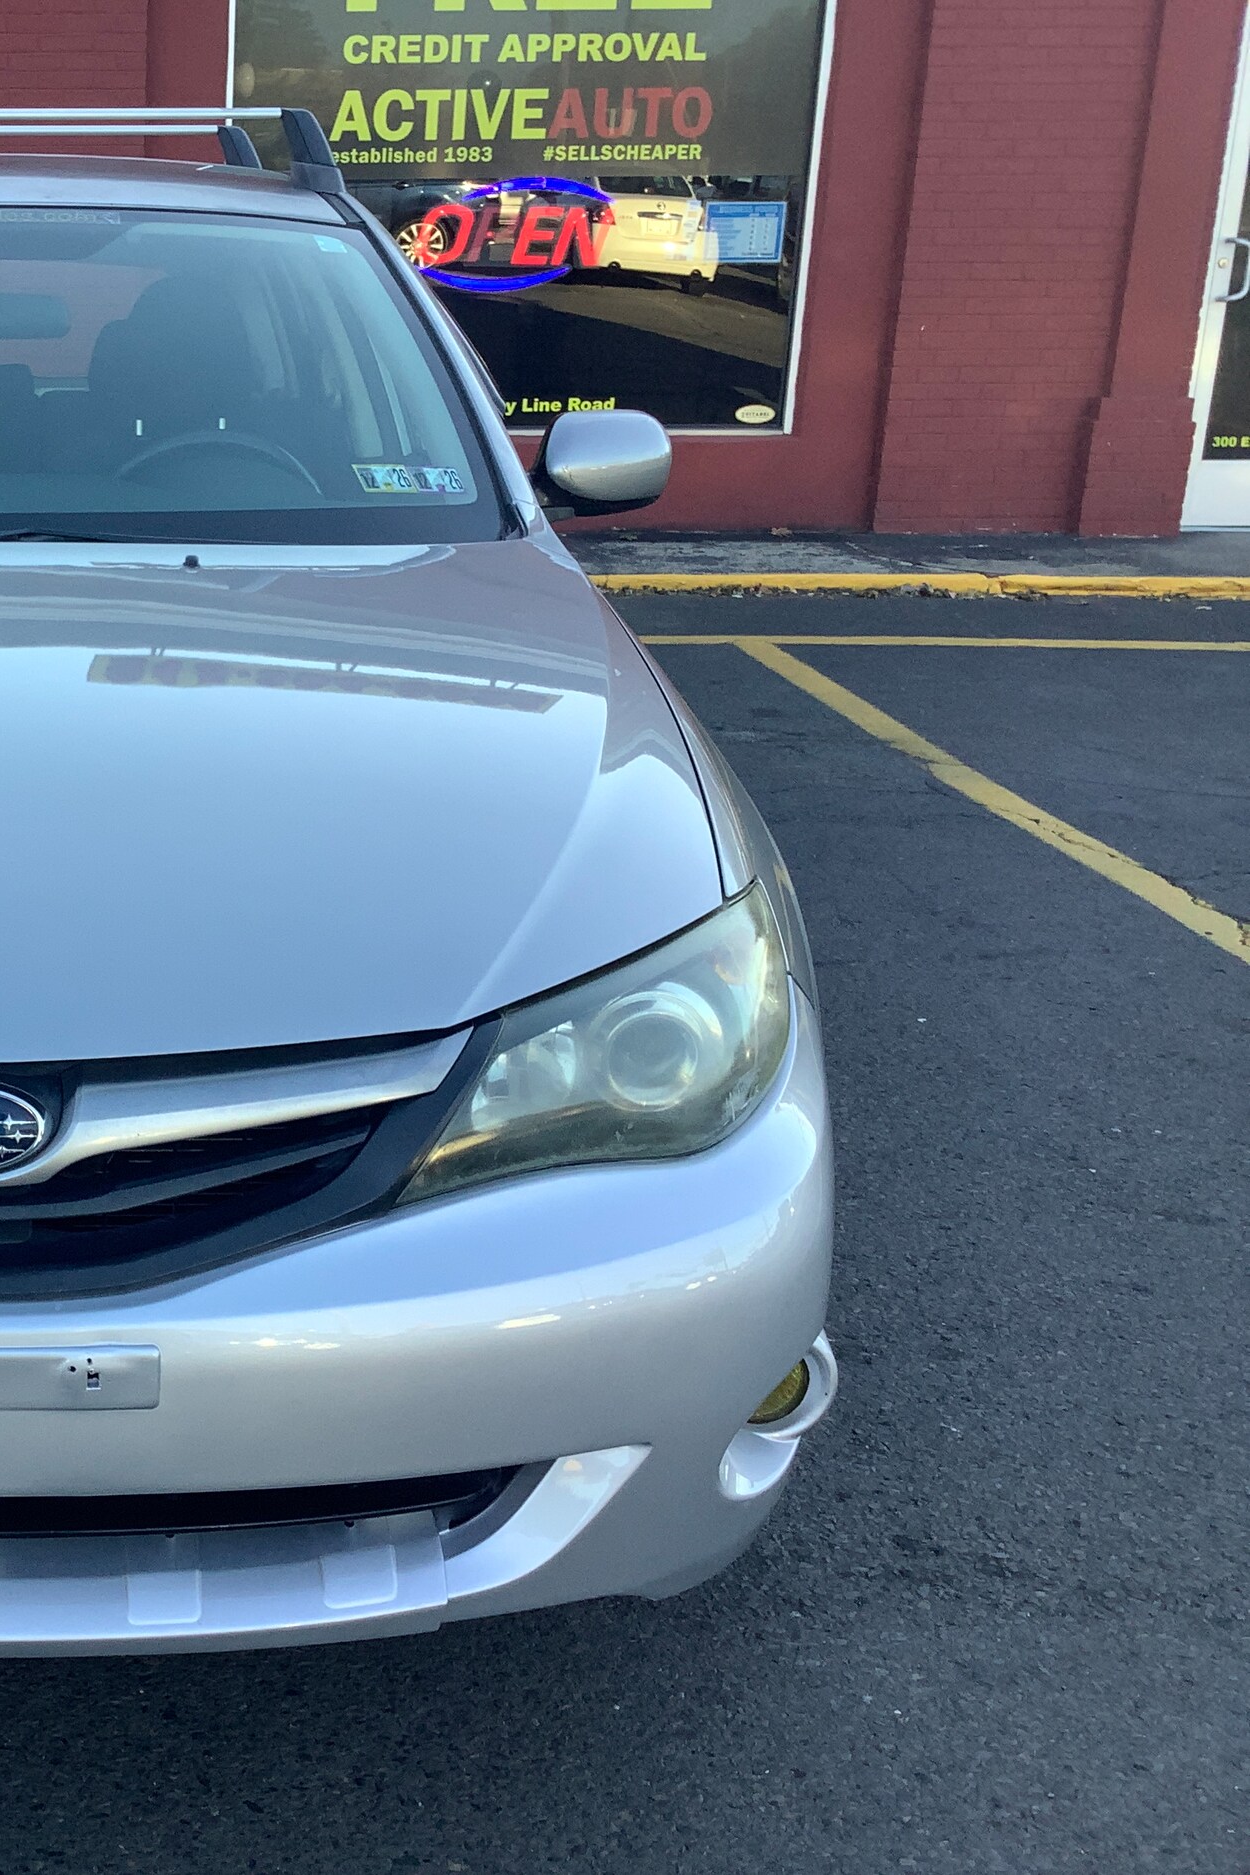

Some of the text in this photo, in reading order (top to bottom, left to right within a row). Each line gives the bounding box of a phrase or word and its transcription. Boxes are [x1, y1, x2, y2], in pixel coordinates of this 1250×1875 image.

[342, 32, 707, 65] CREDIT APPROVAL
[329, 87, 712, 141] ACTIVEAUTO
[333, 146, 493, 164] established 1983
[543, 143, 702, 162] #SELLSCHEAPER
[412, 203, 616, 268] OPEN
[521, 398, 562, 412] Line
[567, 397, 616, 411] Road
[1211, 436, 1238, 448] 300
[392, 468, 412, 488] 26
[444, 470, 463, 490] 26
